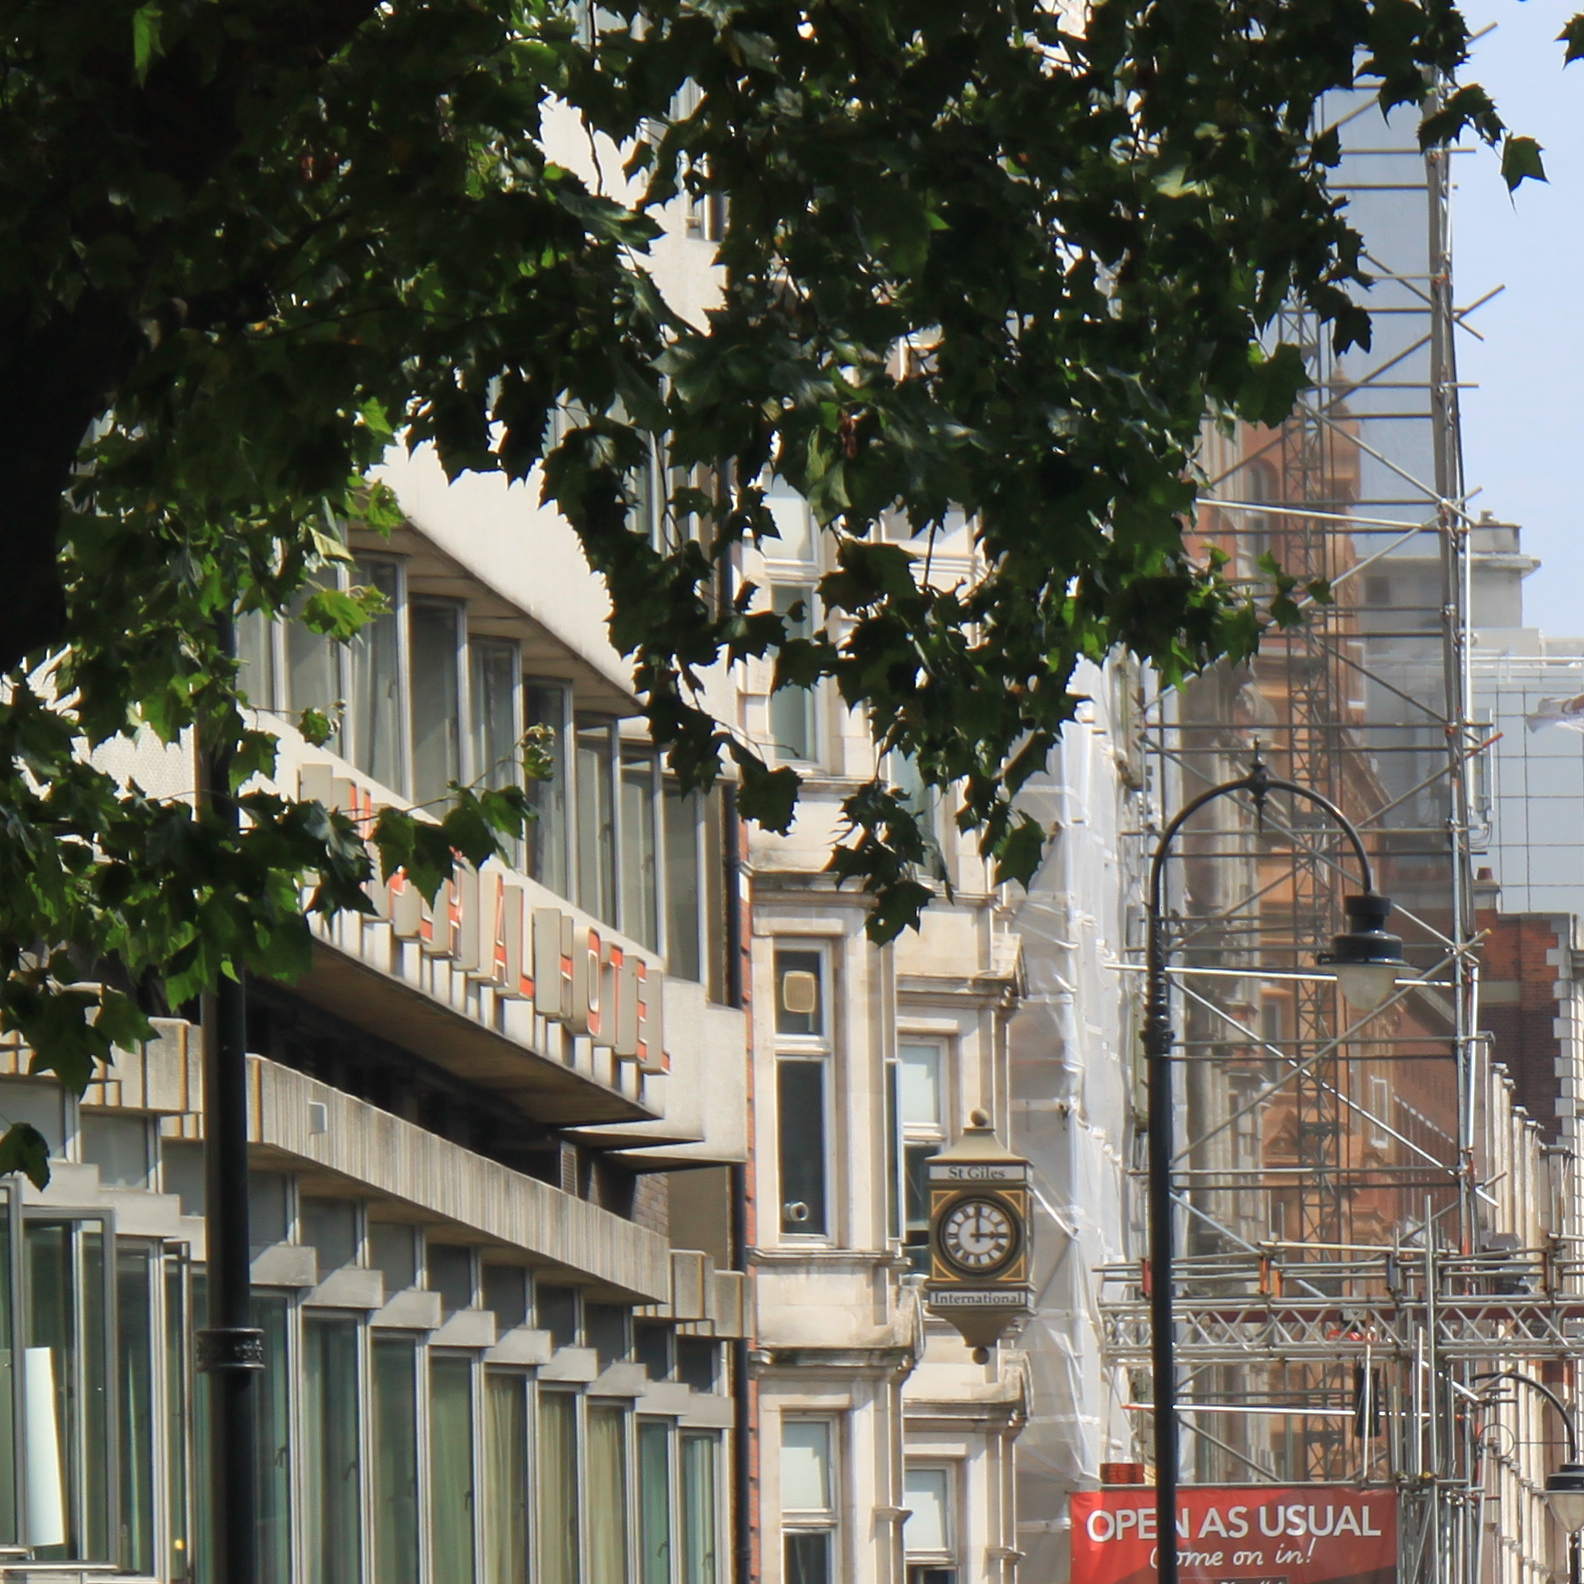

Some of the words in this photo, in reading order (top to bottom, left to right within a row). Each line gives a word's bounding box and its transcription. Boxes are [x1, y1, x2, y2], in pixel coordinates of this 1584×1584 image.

[949, 1167, 963, 1179] St
[968, 1167, 1005, 1179] Giles
[935, 1291, 1022, 1305] International
[1198, 1506, 1249, 1538] AS
[1259, 1504, 1382, 1537] USUAL
[1233, 1551, 1263, 1566] on
[1275, 1537, 1316, 1564] in!
